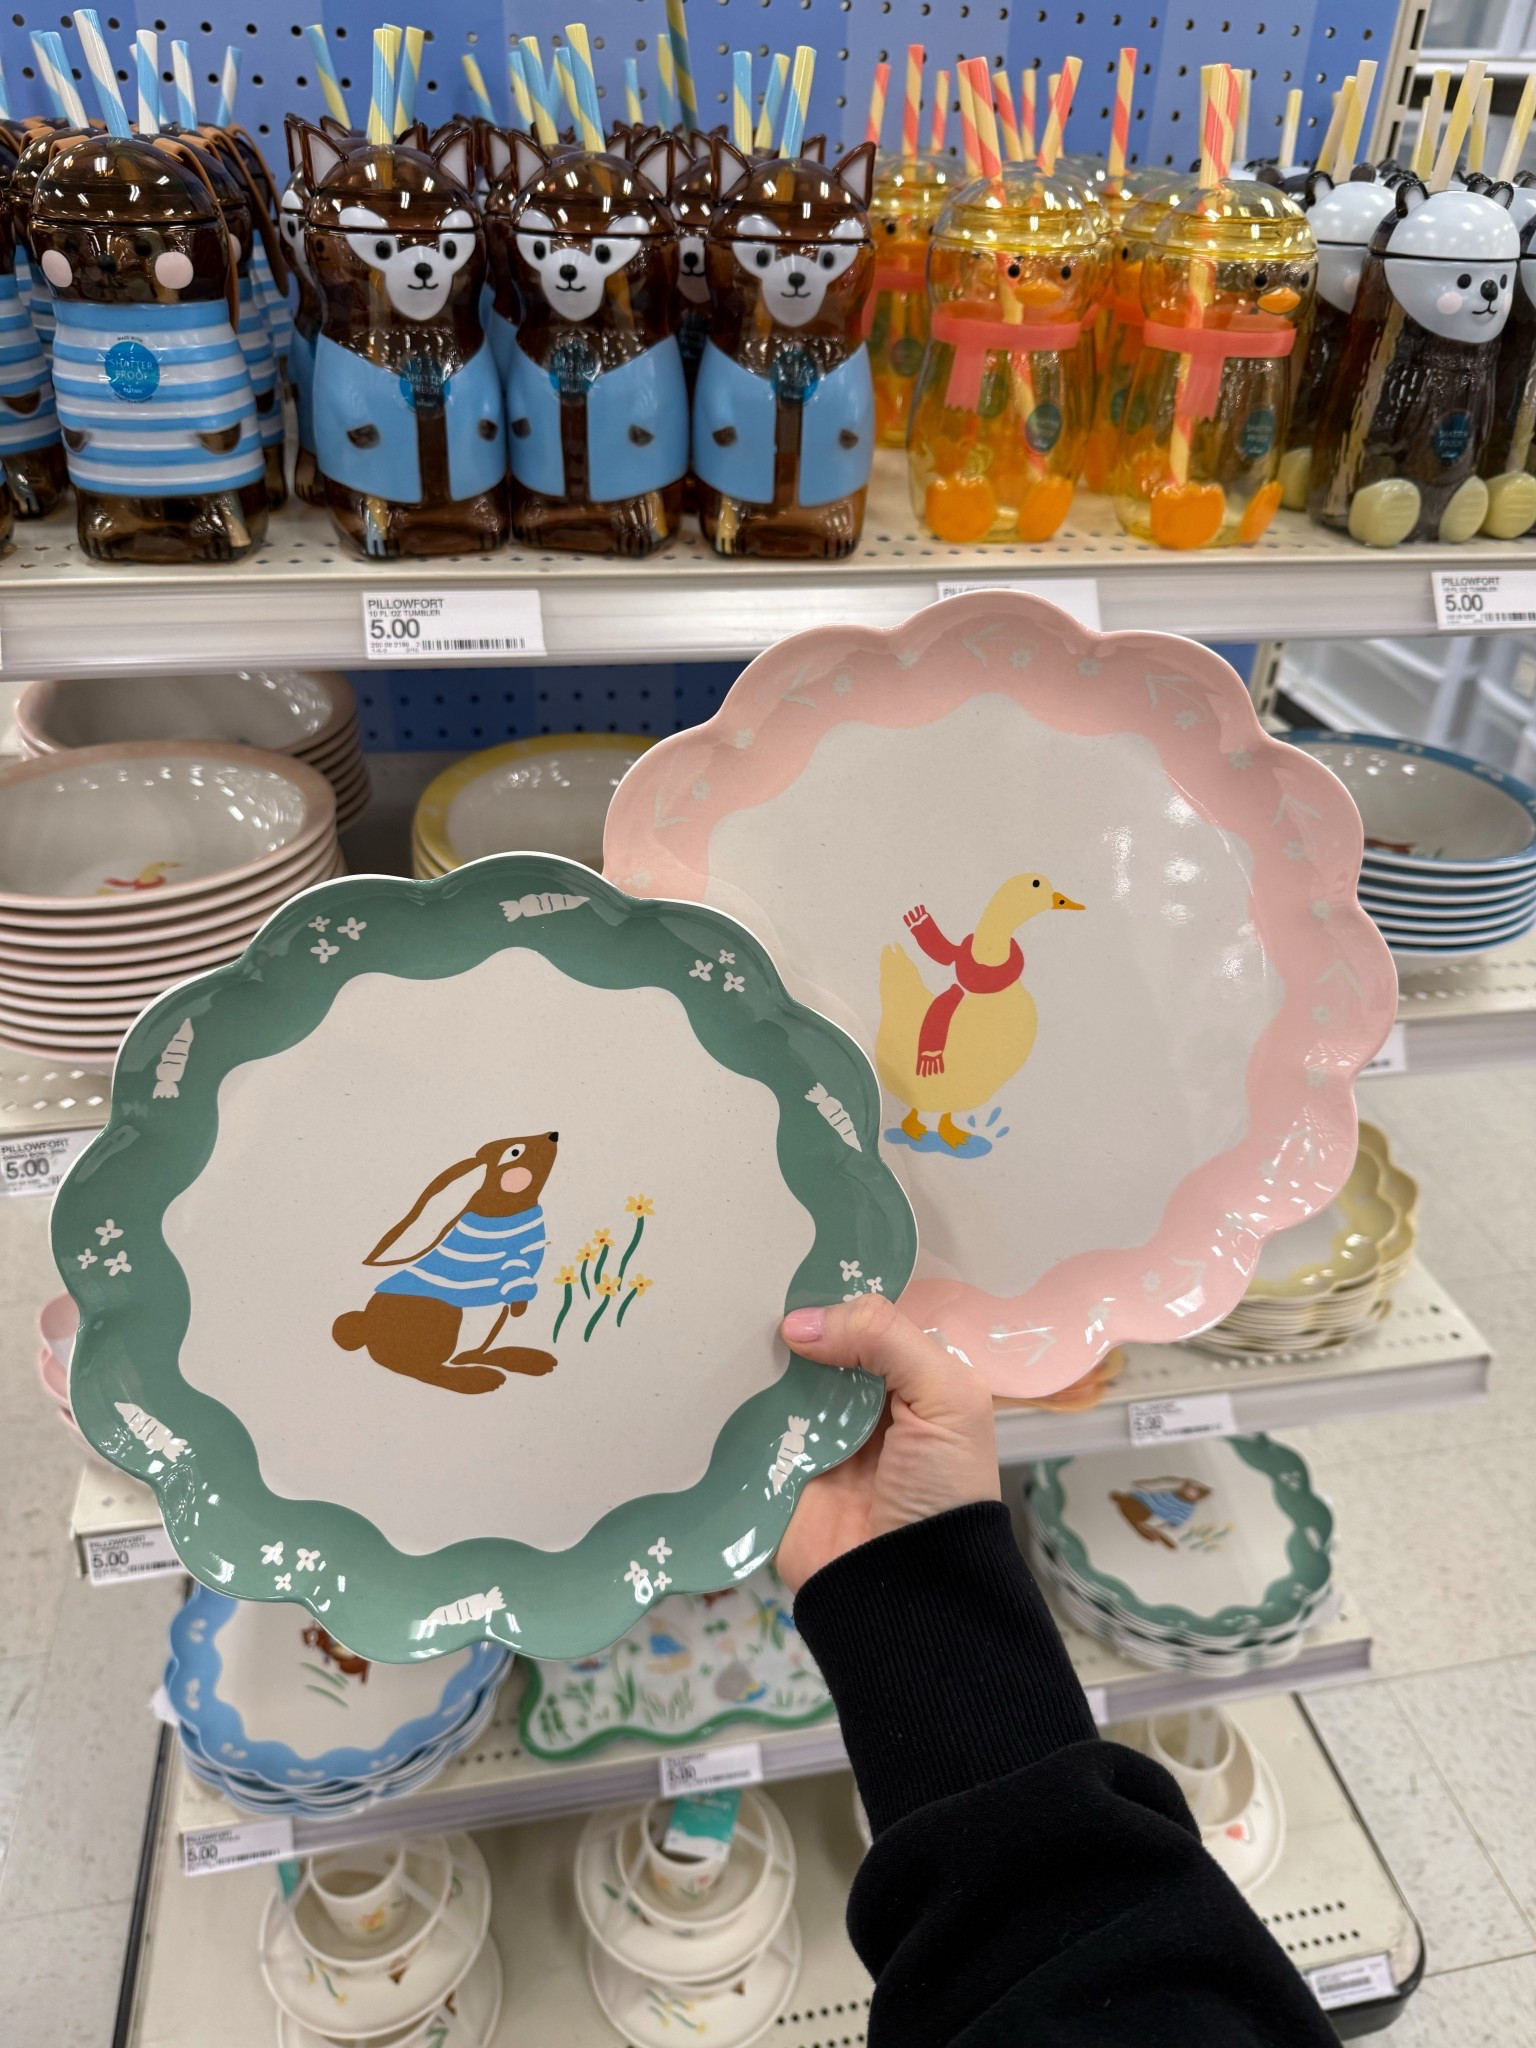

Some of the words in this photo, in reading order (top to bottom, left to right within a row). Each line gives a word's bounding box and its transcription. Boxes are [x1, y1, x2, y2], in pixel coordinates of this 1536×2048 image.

[110, 359, 153, 371] SHATTER
[115, 370, 148, 380] PROOF
[1441, 576, 1500, 587] PILLOWFORT
[368, 598, 445, 610] PILLOWFORT
[1445, 594, 1483, 612] 5.00
[403, 609, 441, 617] TUMBLER
[371, 618, 420, 639] 5.00
[1, 1138, 69, 1154] PILLOWFORT
[6, 1158, 50, 1179] 5.00
[93, 1550, 129, 1569] 5.00
